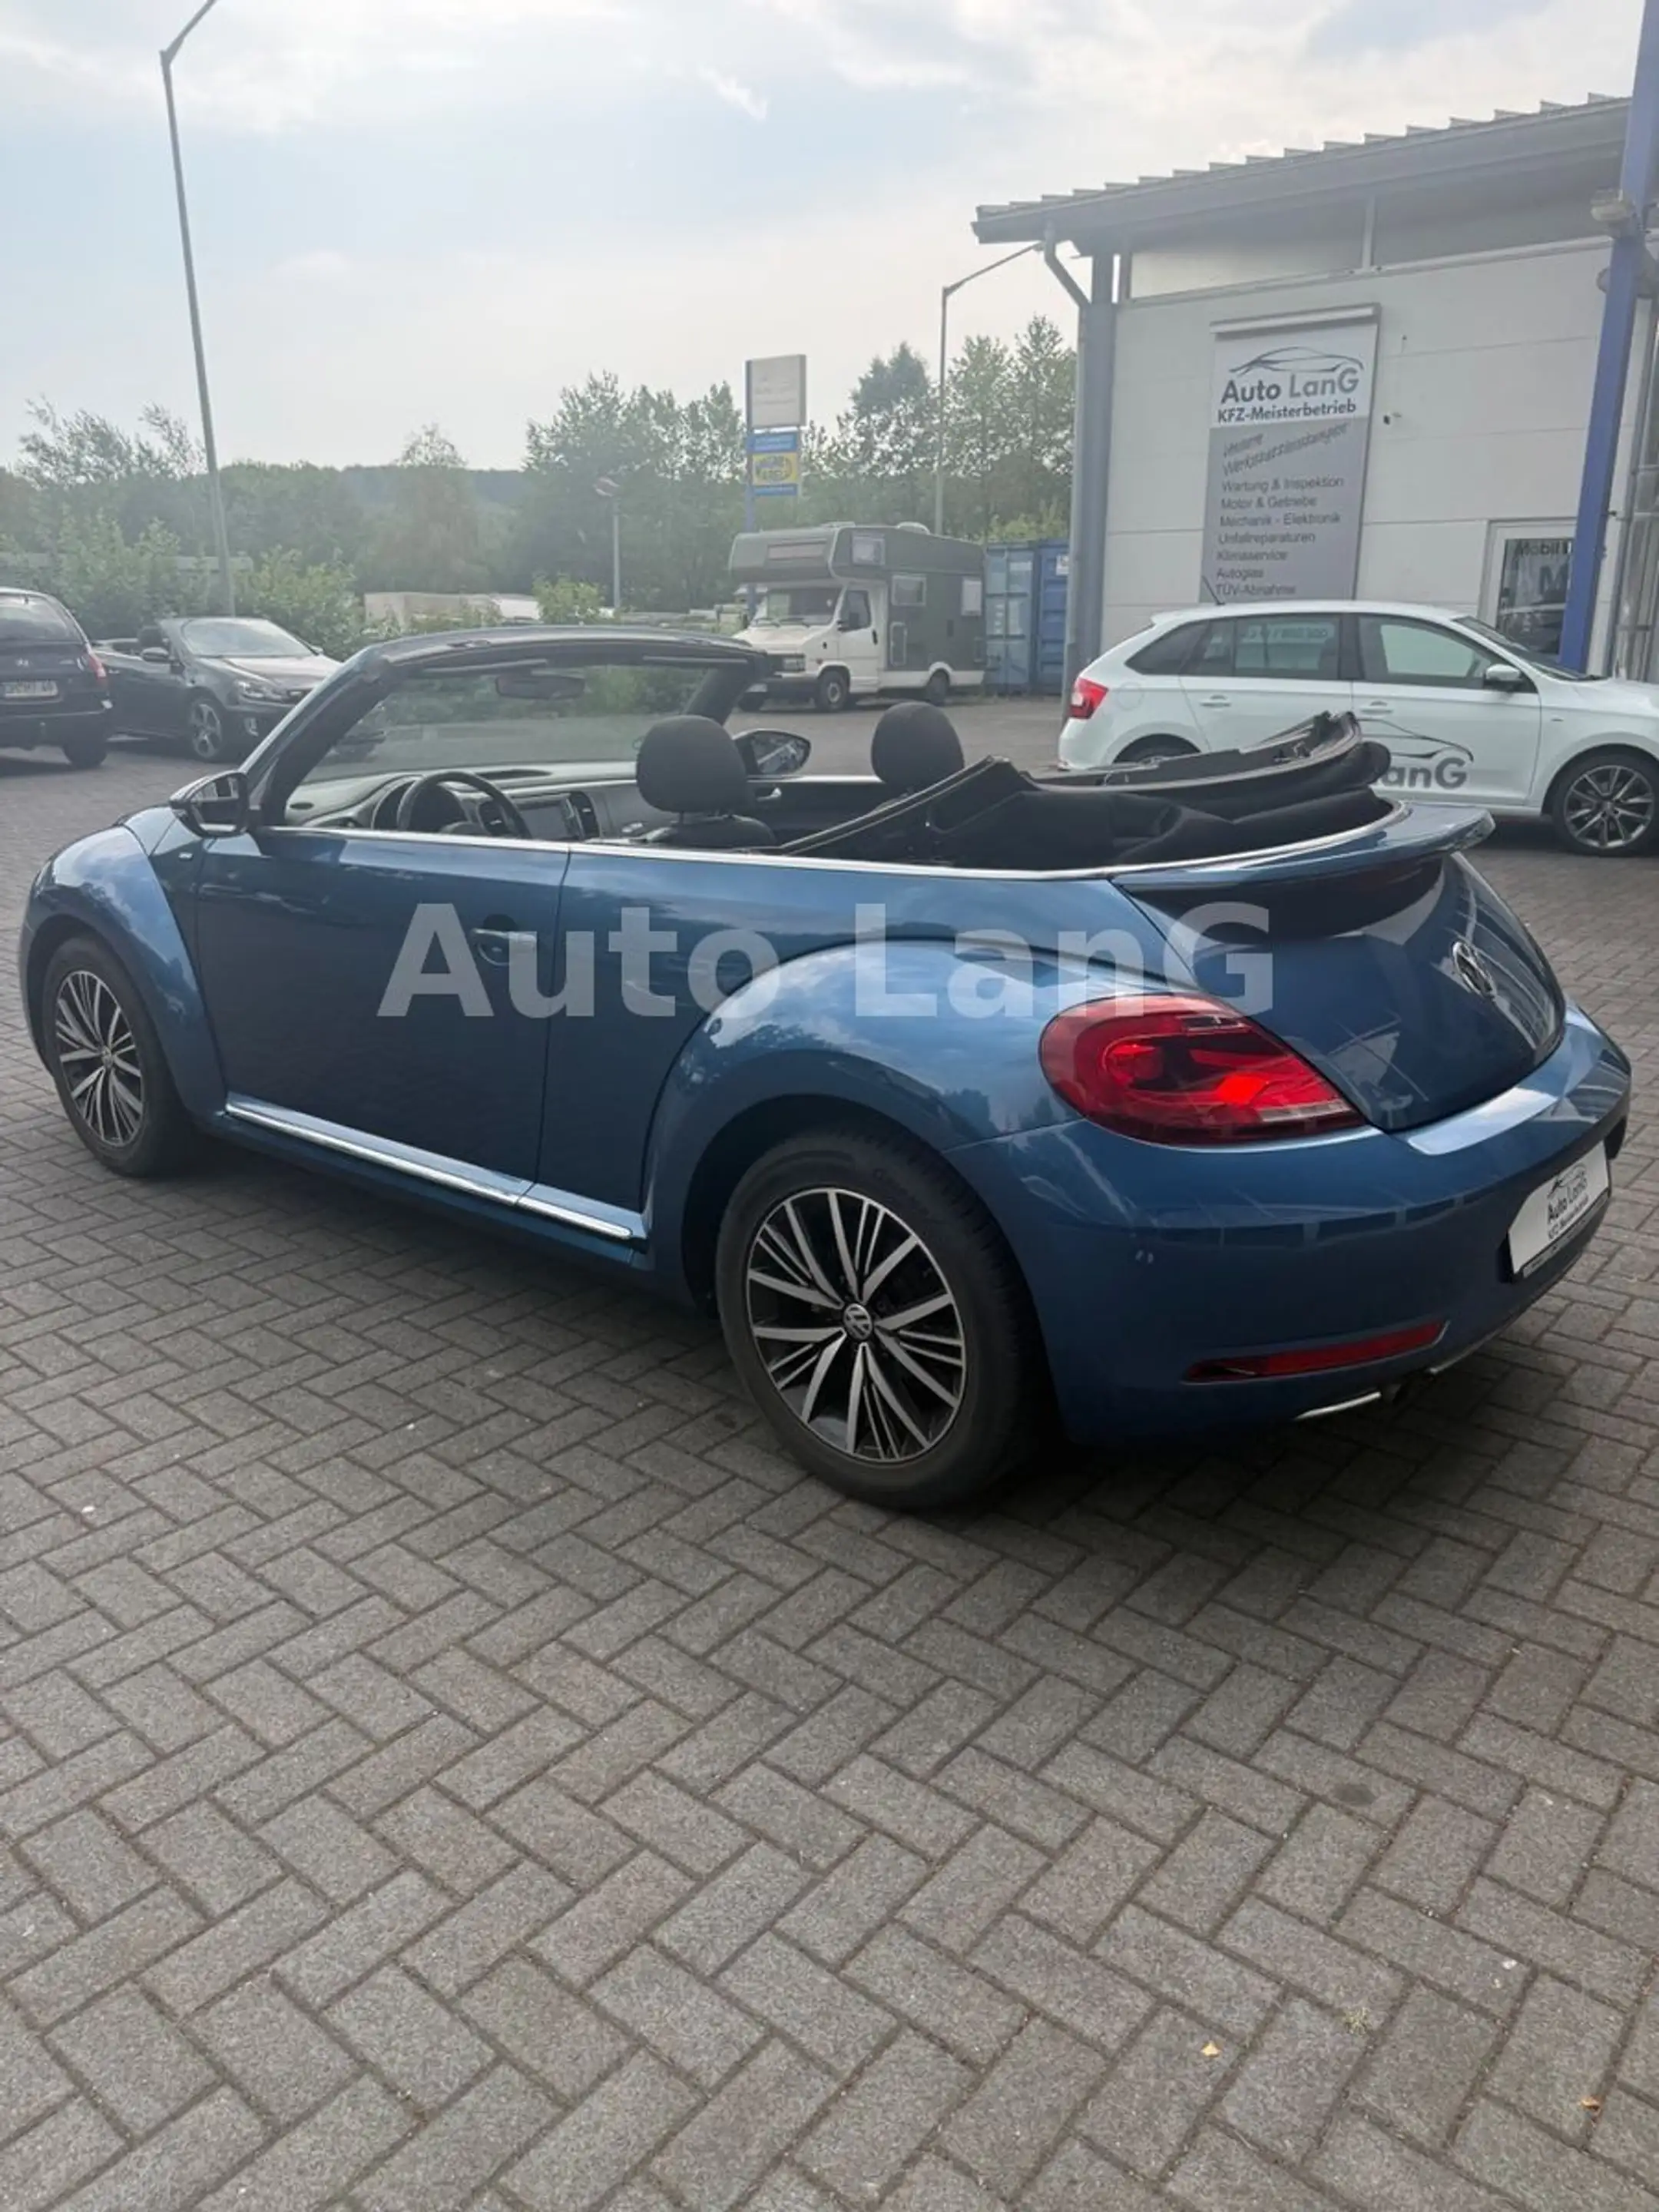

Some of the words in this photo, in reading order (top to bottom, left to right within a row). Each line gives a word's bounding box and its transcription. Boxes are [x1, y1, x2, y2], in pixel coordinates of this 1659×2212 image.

[1220, 379, 1281, 404] Auto
[1289, 368, 1359, 398] LanG
[1217, 398, 1356, 423] KFZ-Meisterbetrieb
[1221, 480, 1269, 494] Wartung
[1271, 478, 1280, 490] &
[1283, 475, 1344, 490] Inspektion
[1220, 498, 1253, 509] Motor
[1256, 497, 1265, 508] &
[1267, 496, 1317, 508] Getriebe
[1283, 512, 1341, 525] Elektronik
[1218, 531, 1316, 545] Unfallreparaturen
[1380, 757, 1467, 790] anG
